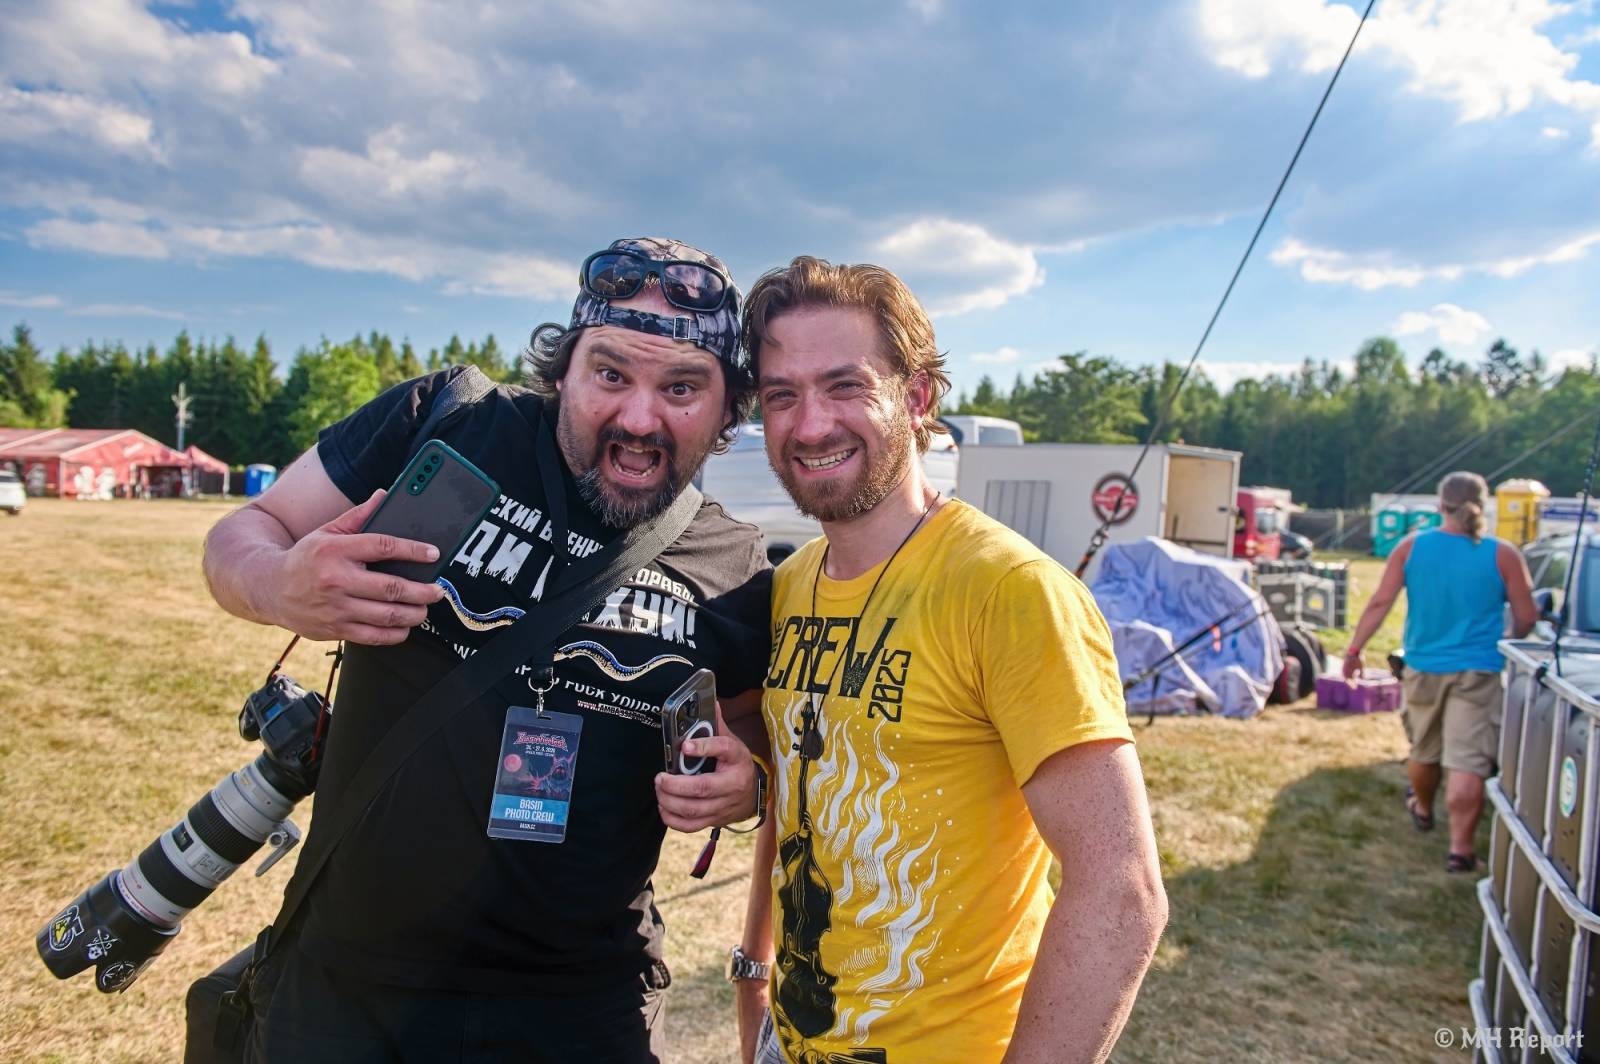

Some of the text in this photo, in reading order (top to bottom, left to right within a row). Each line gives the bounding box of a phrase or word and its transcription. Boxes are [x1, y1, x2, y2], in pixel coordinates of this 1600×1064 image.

[490, 493, 542, 533] СКИЙ
[449, 519, 534, 586] ДИ
[766, 615, 898, 699] CREW
[867, 648, 912, 723] 2025
[504, 808, 555, 823] PHOTO CREW
[519, 798, 543, 811] BASIN
